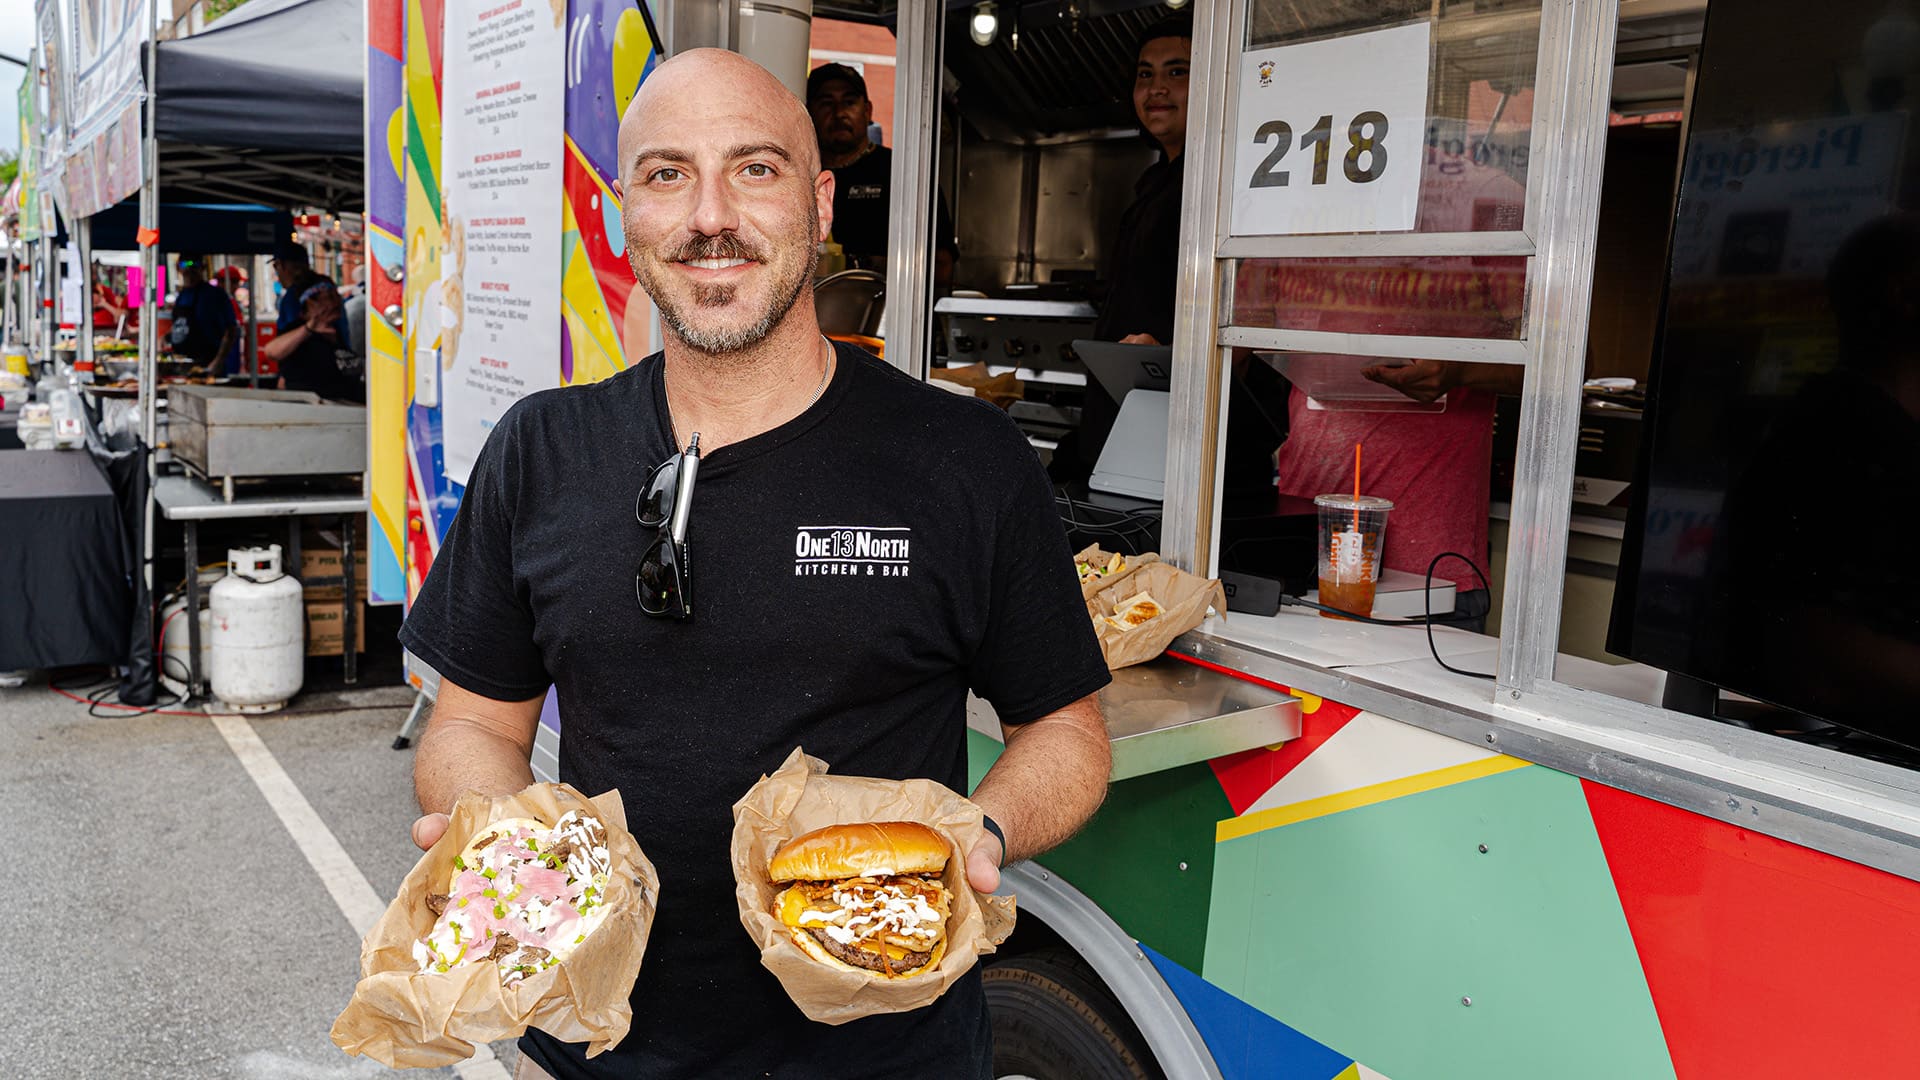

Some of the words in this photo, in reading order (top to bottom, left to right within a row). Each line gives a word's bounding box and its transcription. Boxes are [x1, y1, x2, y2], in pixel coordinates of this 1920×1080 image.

[1249, 111, 1388, 188] 218
[796, 564, 858, 576] KITCHEN
[866, 565, 875, 576] &
[882, 565, 909, 577] BAR
